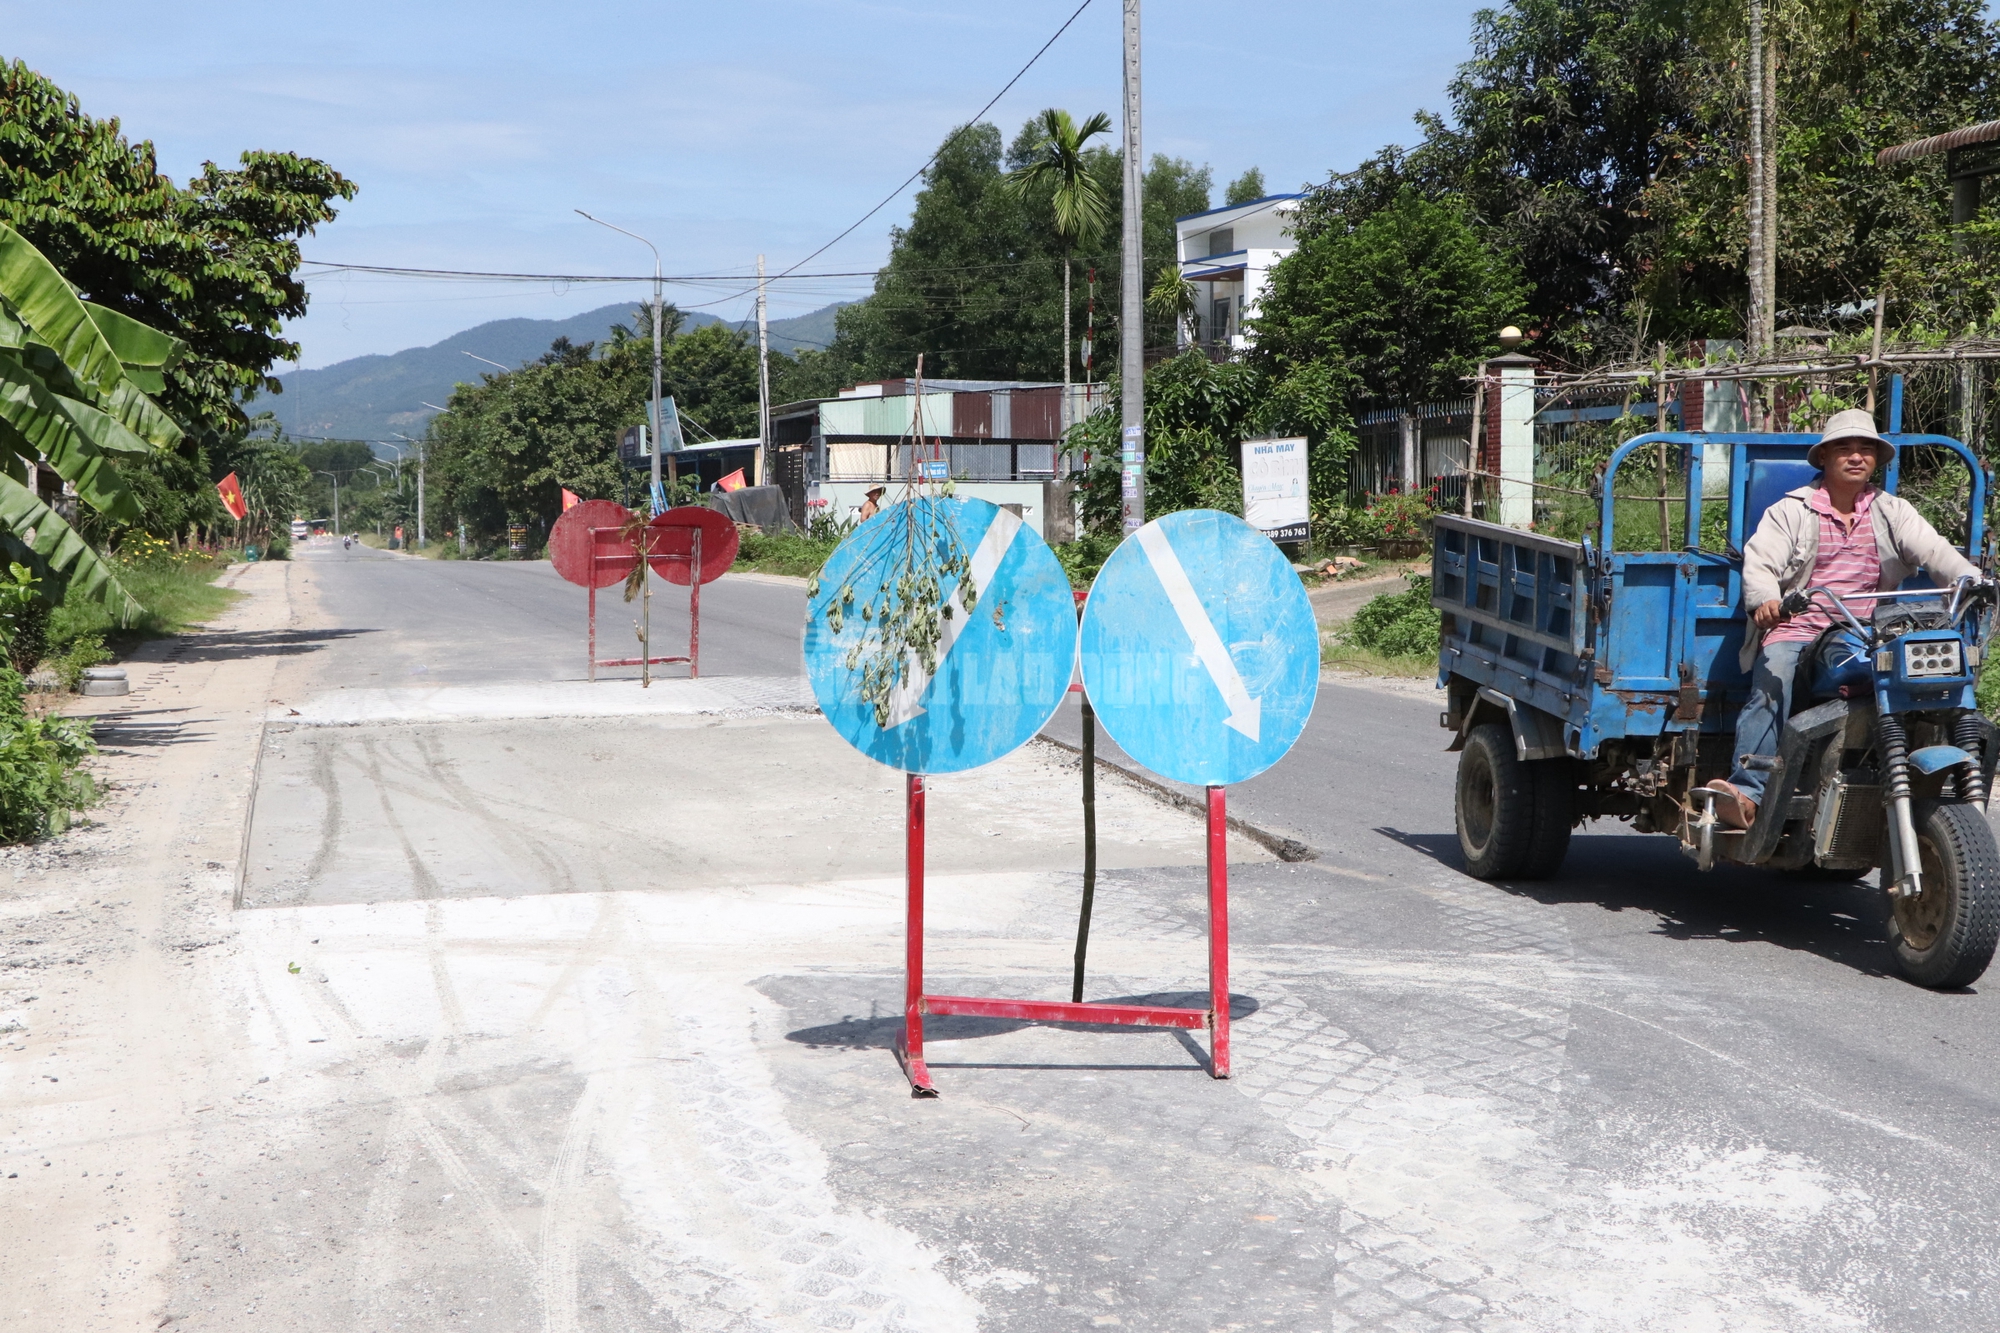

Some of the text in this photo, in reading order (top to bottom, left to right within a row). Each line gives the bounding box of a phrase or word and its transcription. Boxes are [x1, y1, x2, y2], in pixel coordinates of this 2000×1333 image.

[1276, 444, 1295, 453] MAY
[1280, 529, 1293, 537] 376
[1294, 528, 1306, 536] 763
